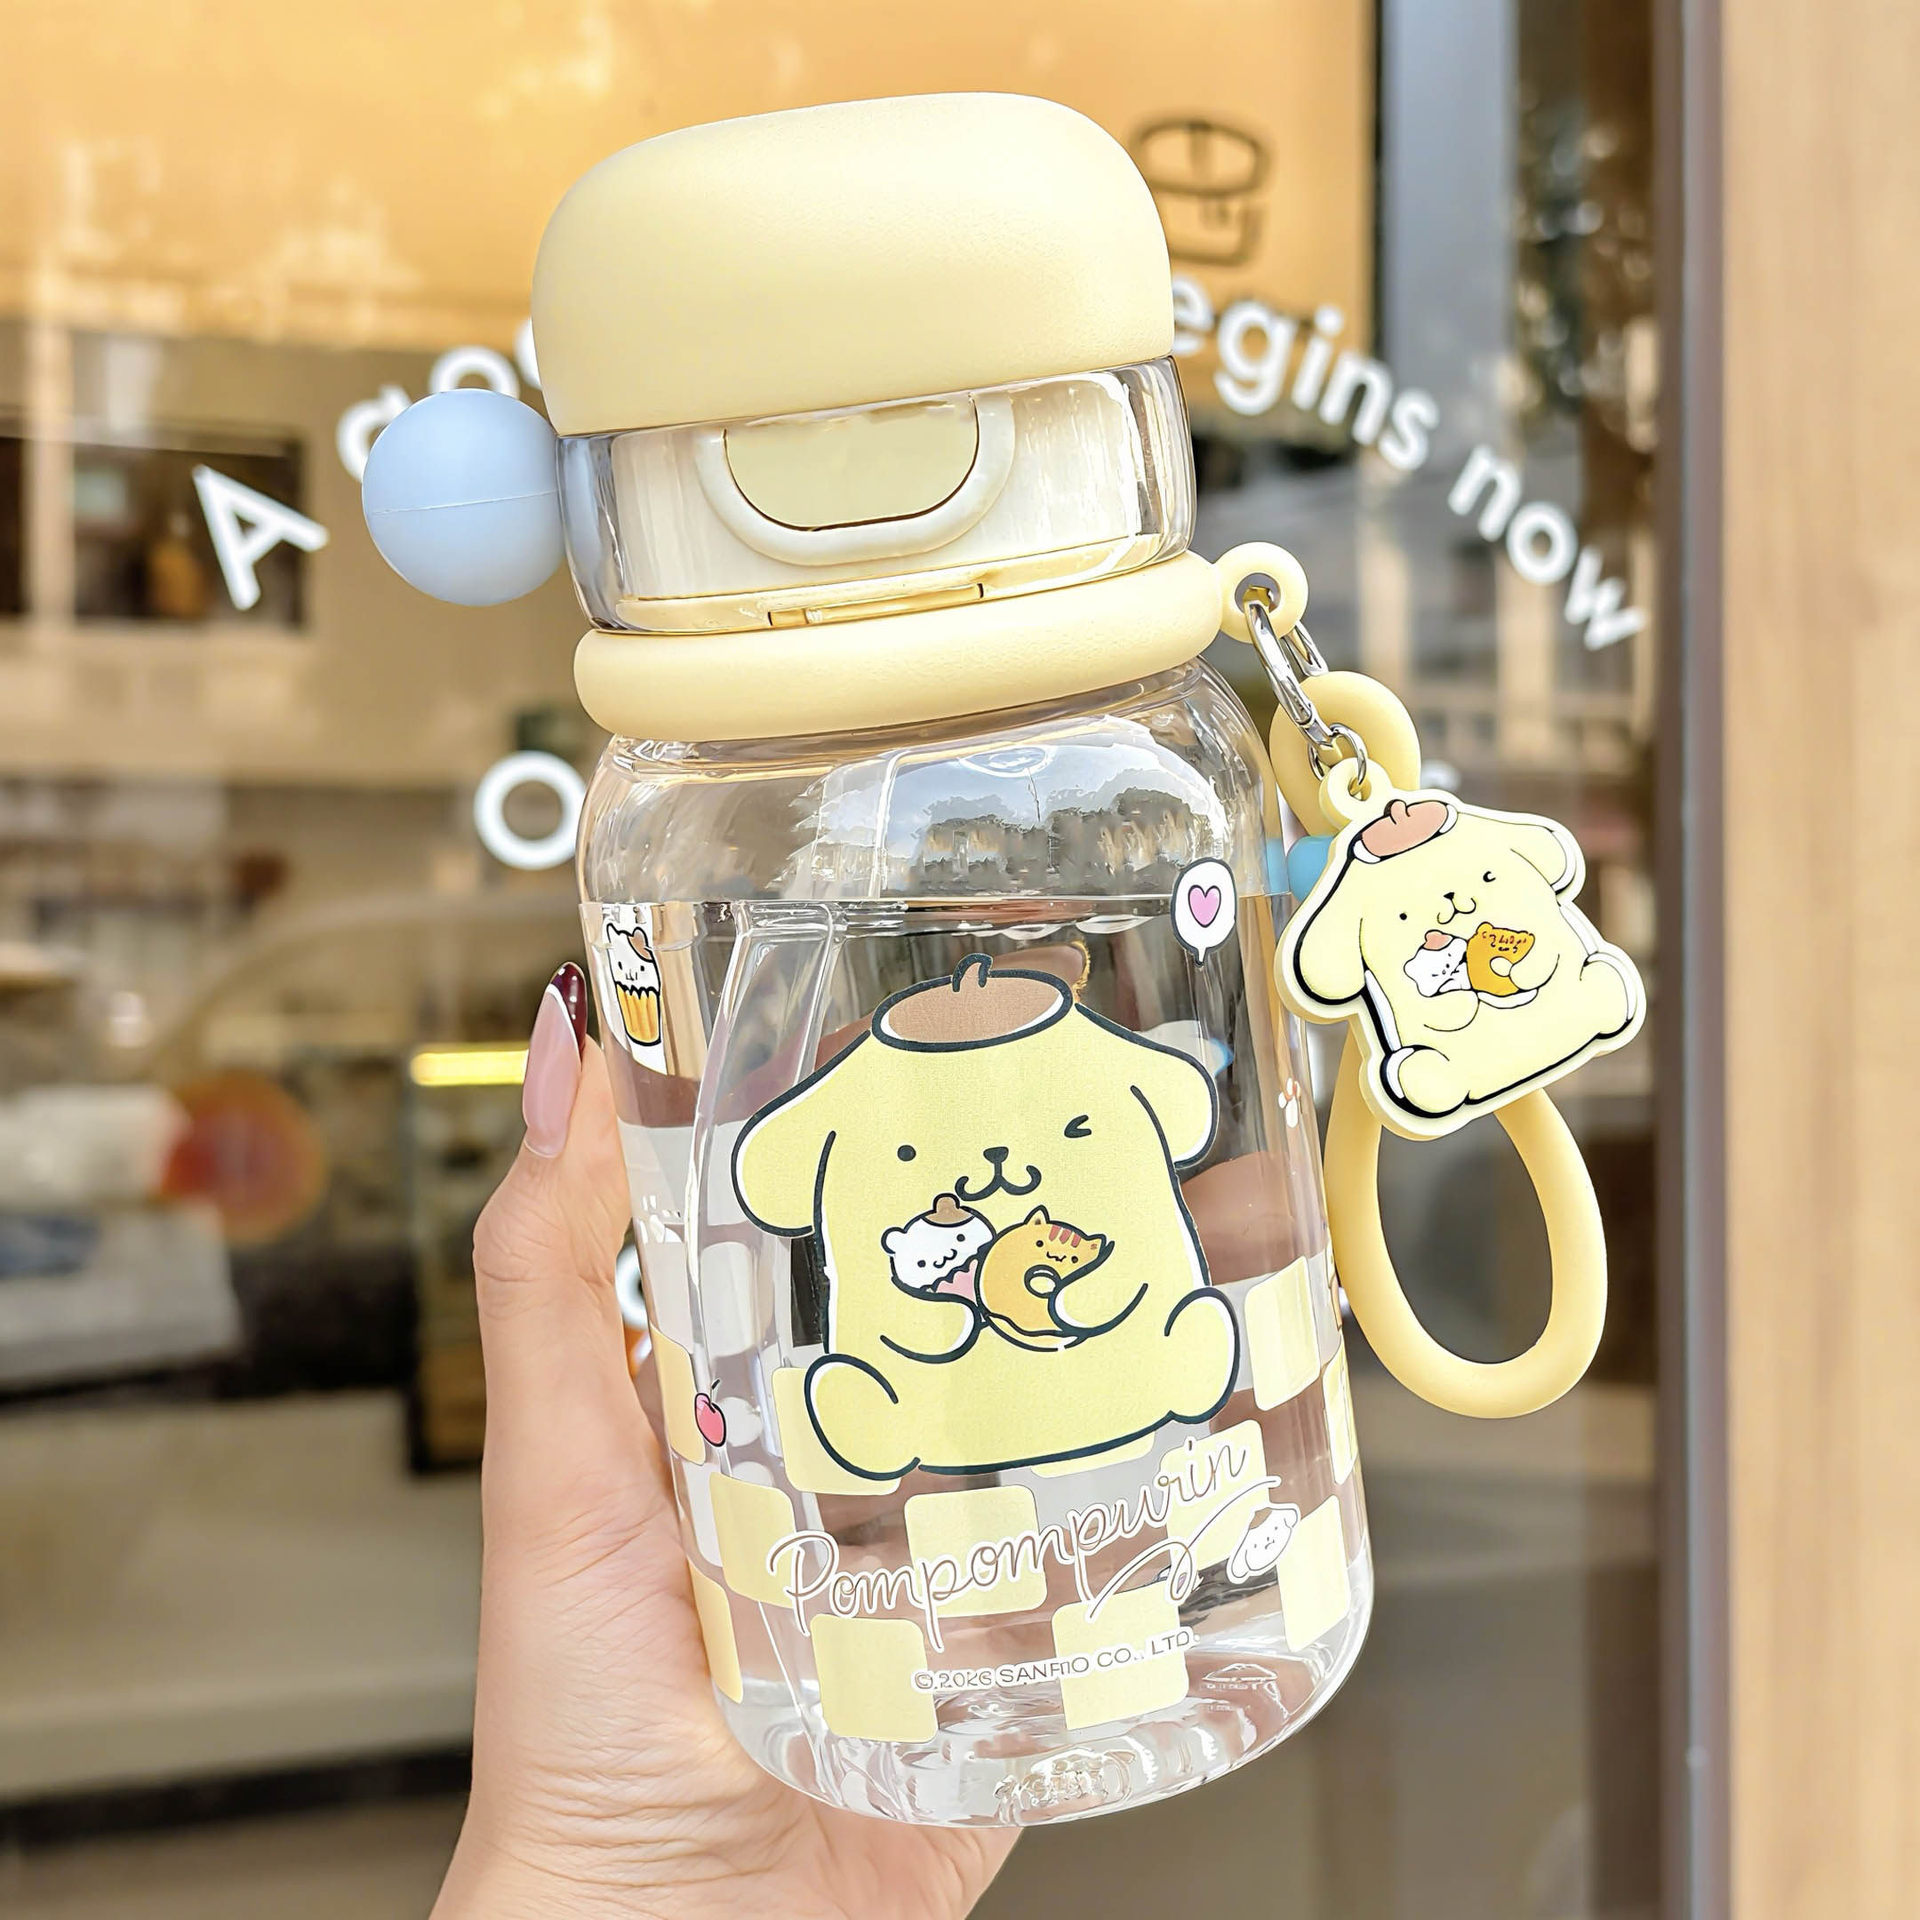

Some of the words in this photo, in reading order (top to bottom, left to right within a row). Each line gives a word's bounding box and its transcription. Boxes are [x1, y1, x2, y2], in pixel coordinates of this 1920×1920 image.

[192, 464, 328, 611] A
[1173, 276, 1439, 471] egins
[1448, 445, 1645, 650] now
[768, 1439, 1247, 1651] Pompompurin
